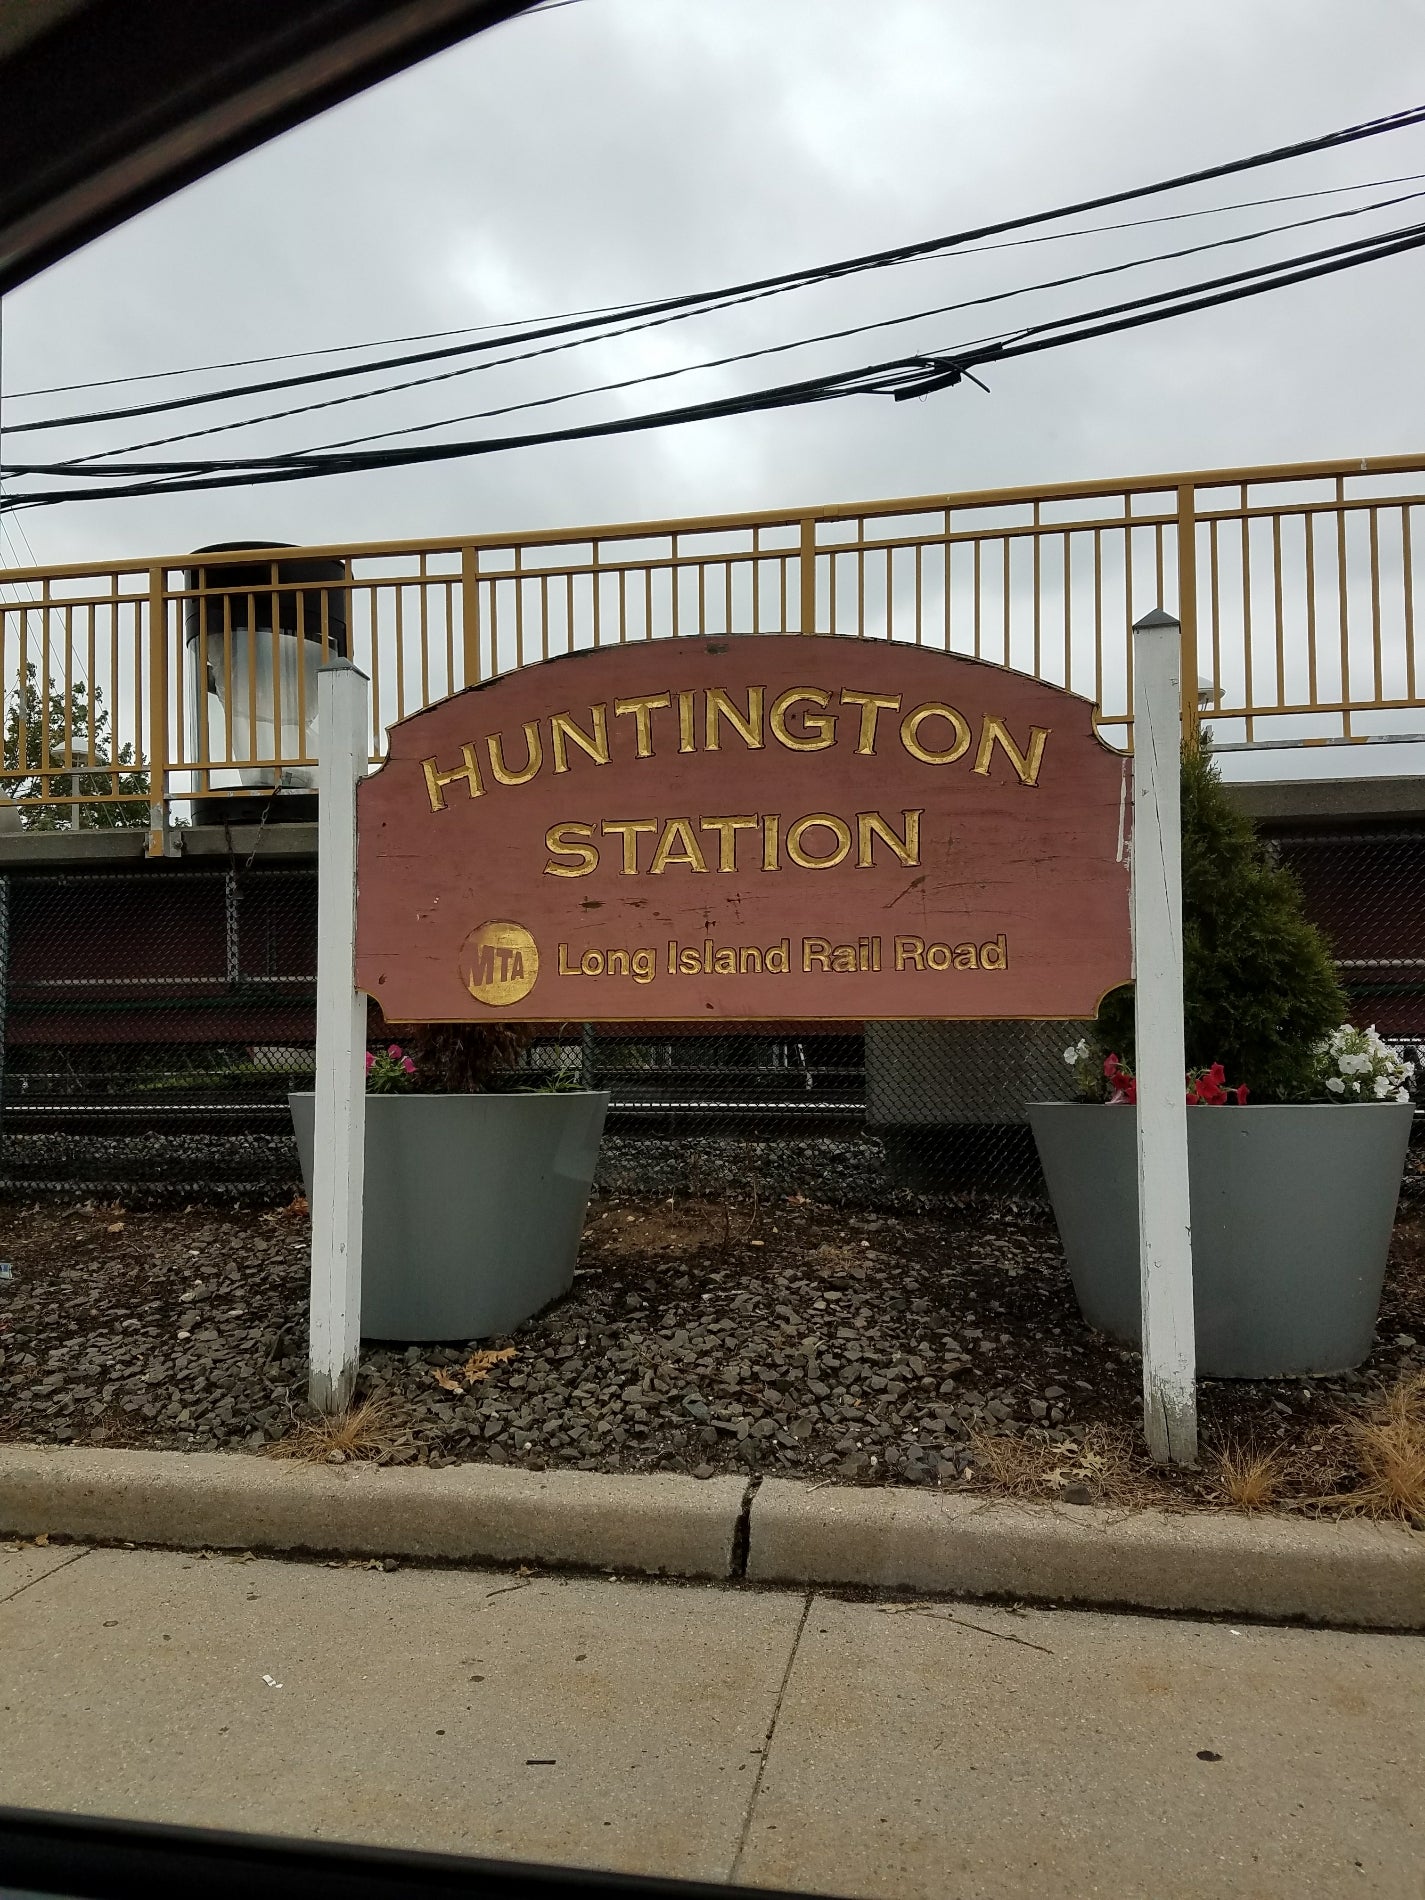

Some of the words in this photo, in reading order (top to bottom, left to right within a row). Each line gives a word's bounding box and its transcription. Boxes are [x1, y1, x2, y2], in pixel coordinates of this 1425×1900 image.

[419, 685, 1051, 813] HUNTINGTON
[543, 809, 925, 879] STATION
[461, 944, 525, 988] MTA
[558, 943, 656, 984] Long
[667, 938, 790, 975] Island
[802, 936, 882, 973] Rail
[894, 934, 1008, 971] Road
